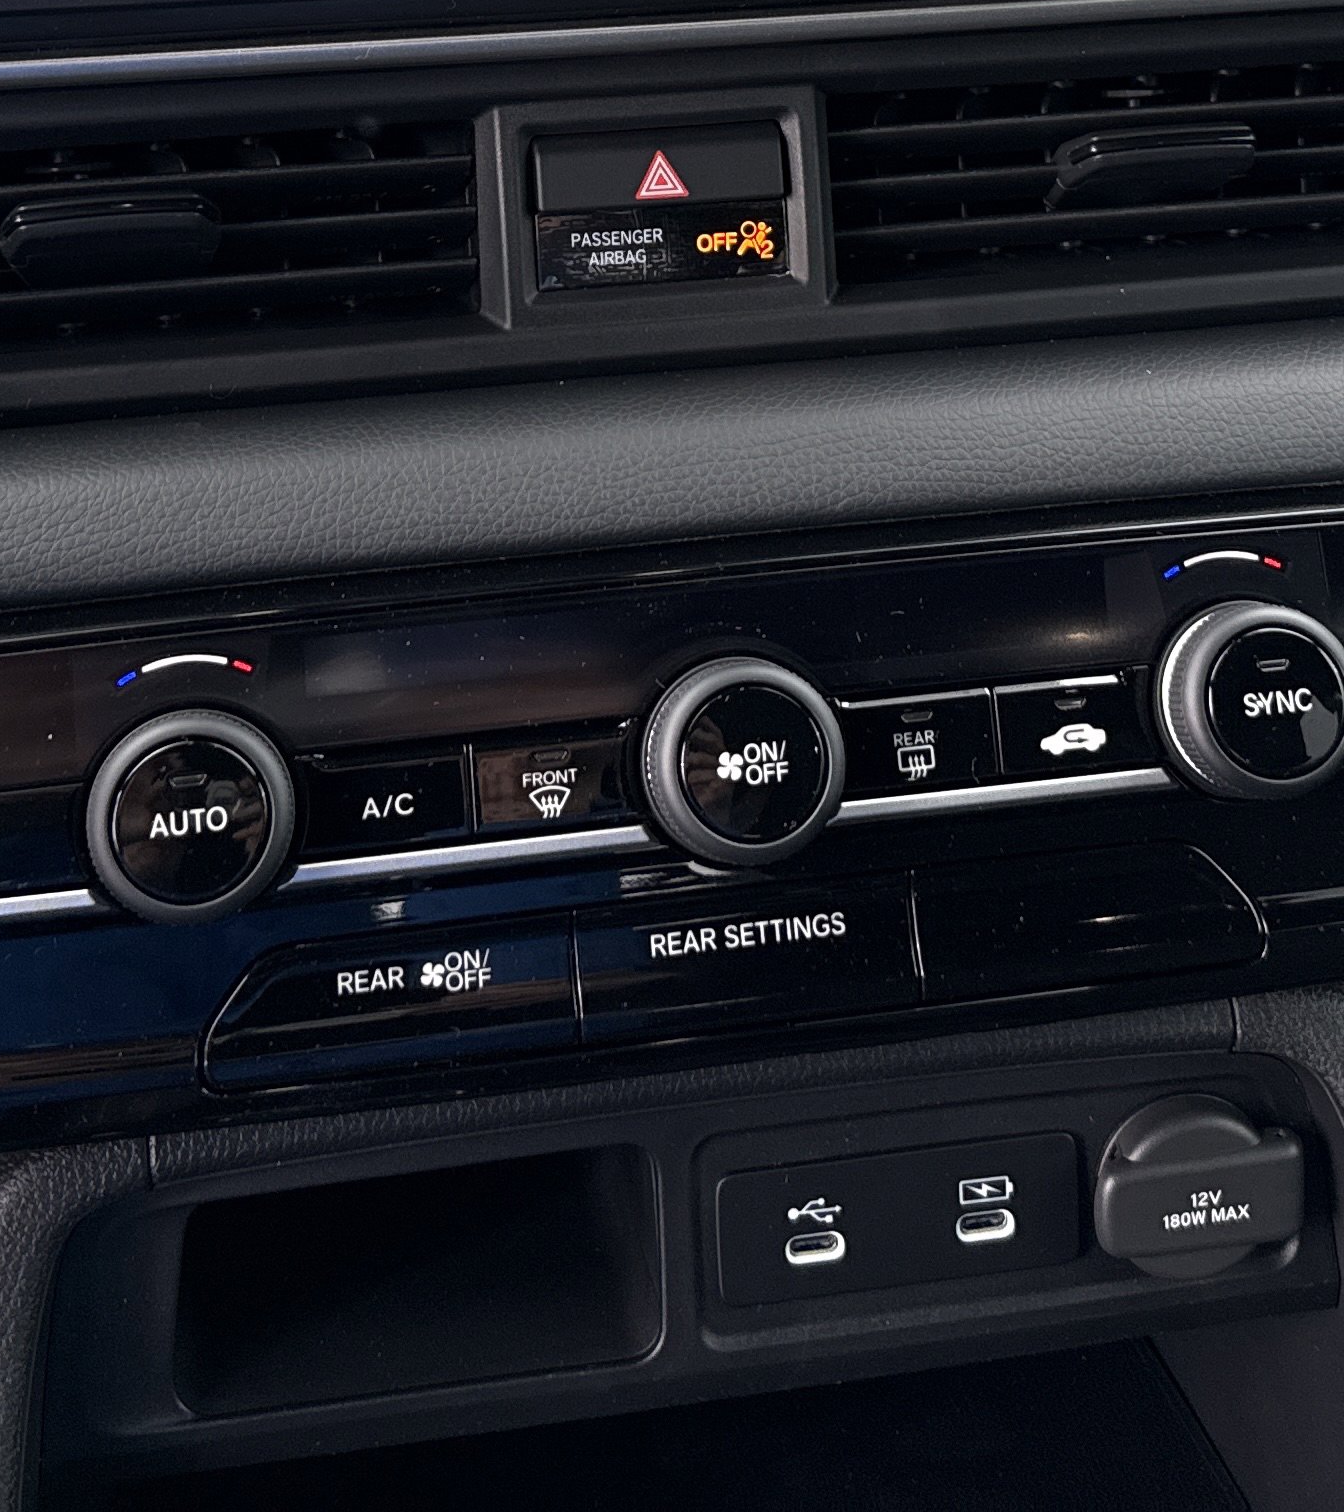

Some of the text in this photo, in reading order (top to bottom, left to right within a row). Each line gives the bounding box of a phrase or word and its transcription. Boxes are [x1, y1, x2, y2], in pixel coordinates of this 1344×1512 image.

[570, 228, 664, 248] PASSENGER
[696, 231, 738, 253] OFF
[588, 248, 647, 266] AIRBAG
[1243, 687, 1313, 717] SYNC
[893, 729, 935, 748] REAR
[522, 767, 578, 788] FRONT
[745, 760, 789, 785] OFF
[362, 792, 414, 820] A/C
[149, 805, 228, 839] AUTO
[650, 911, 846, 958] REAR SETTINGS
[337, 966, 405, 995] REAR
[445, 967, 492, 992] OFF
[1190, 1189, 1222, 1208] 12V
[1162, 1203, 1250, 1230] 180W MAX
